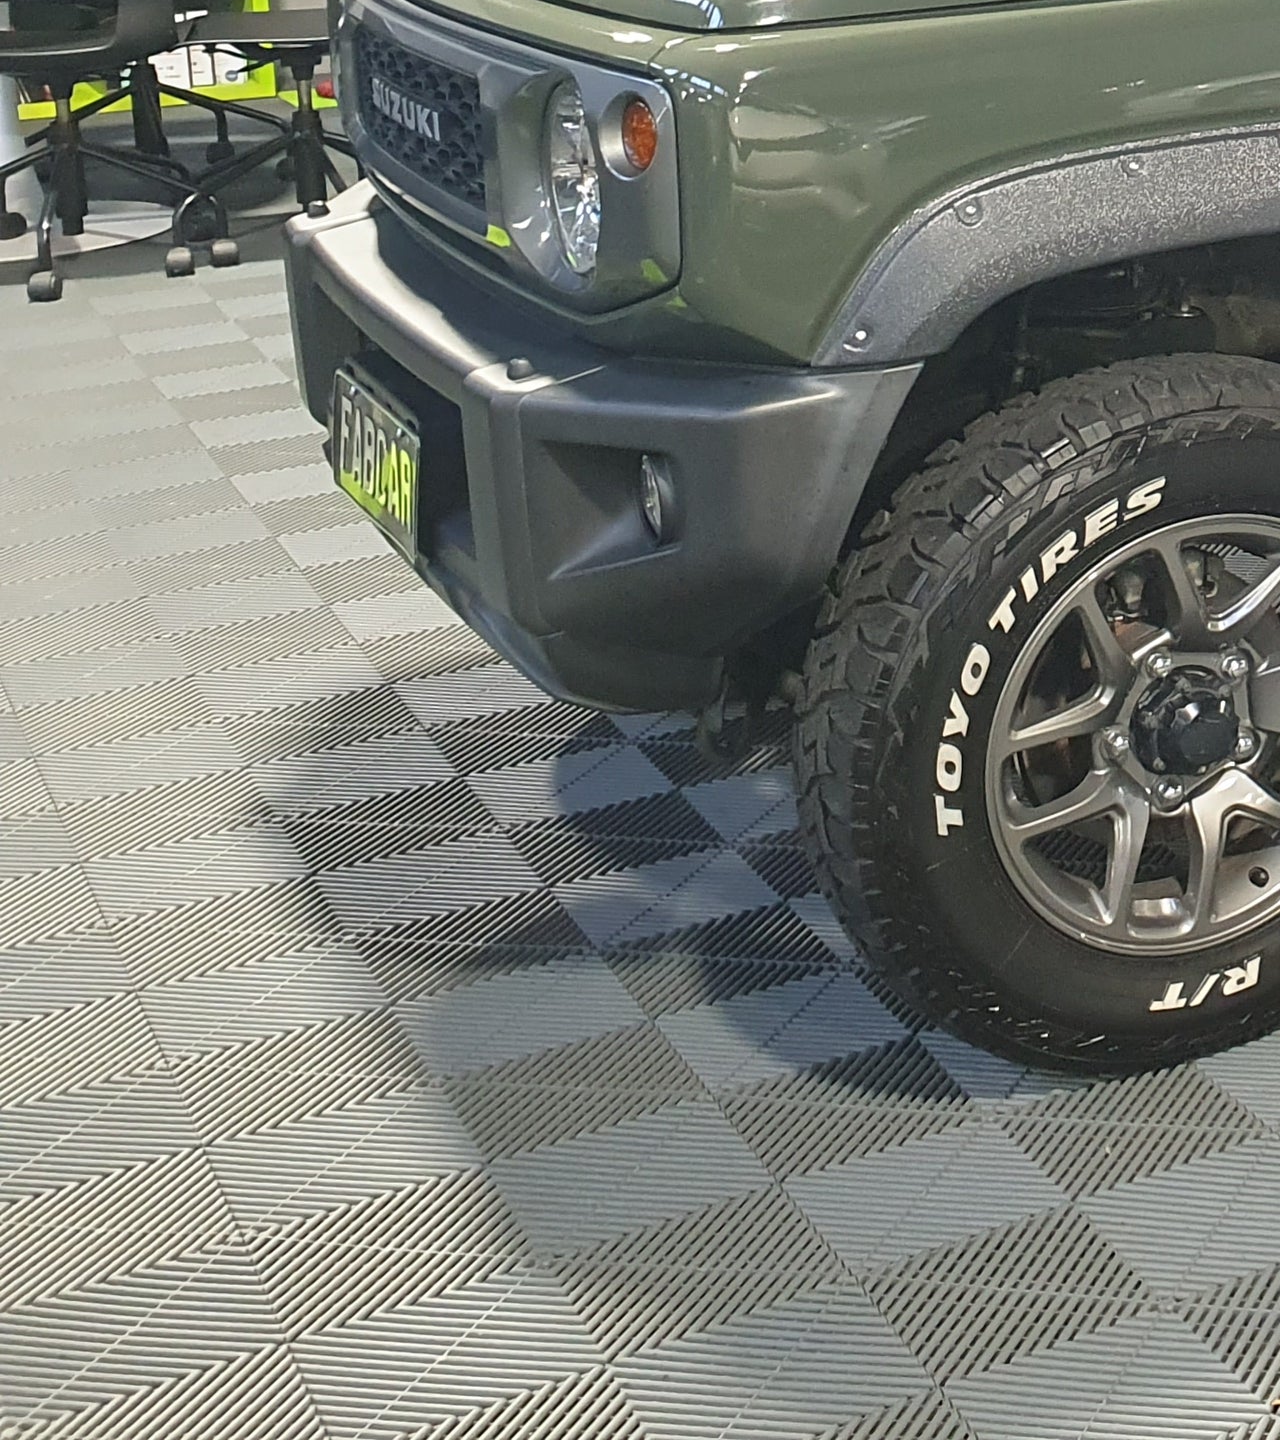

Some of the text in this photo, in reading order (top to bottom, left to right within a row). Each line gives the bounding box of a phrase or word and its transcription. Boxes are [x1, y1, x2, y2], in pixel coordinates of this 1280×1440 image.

[371, 76, 441, 142] SUZUKI
[340, 394, 413, 534] FABCAR
[934, 474, 1168, 838] TOYO TIRES
[1149, 955, 1261, 1013] R/T
